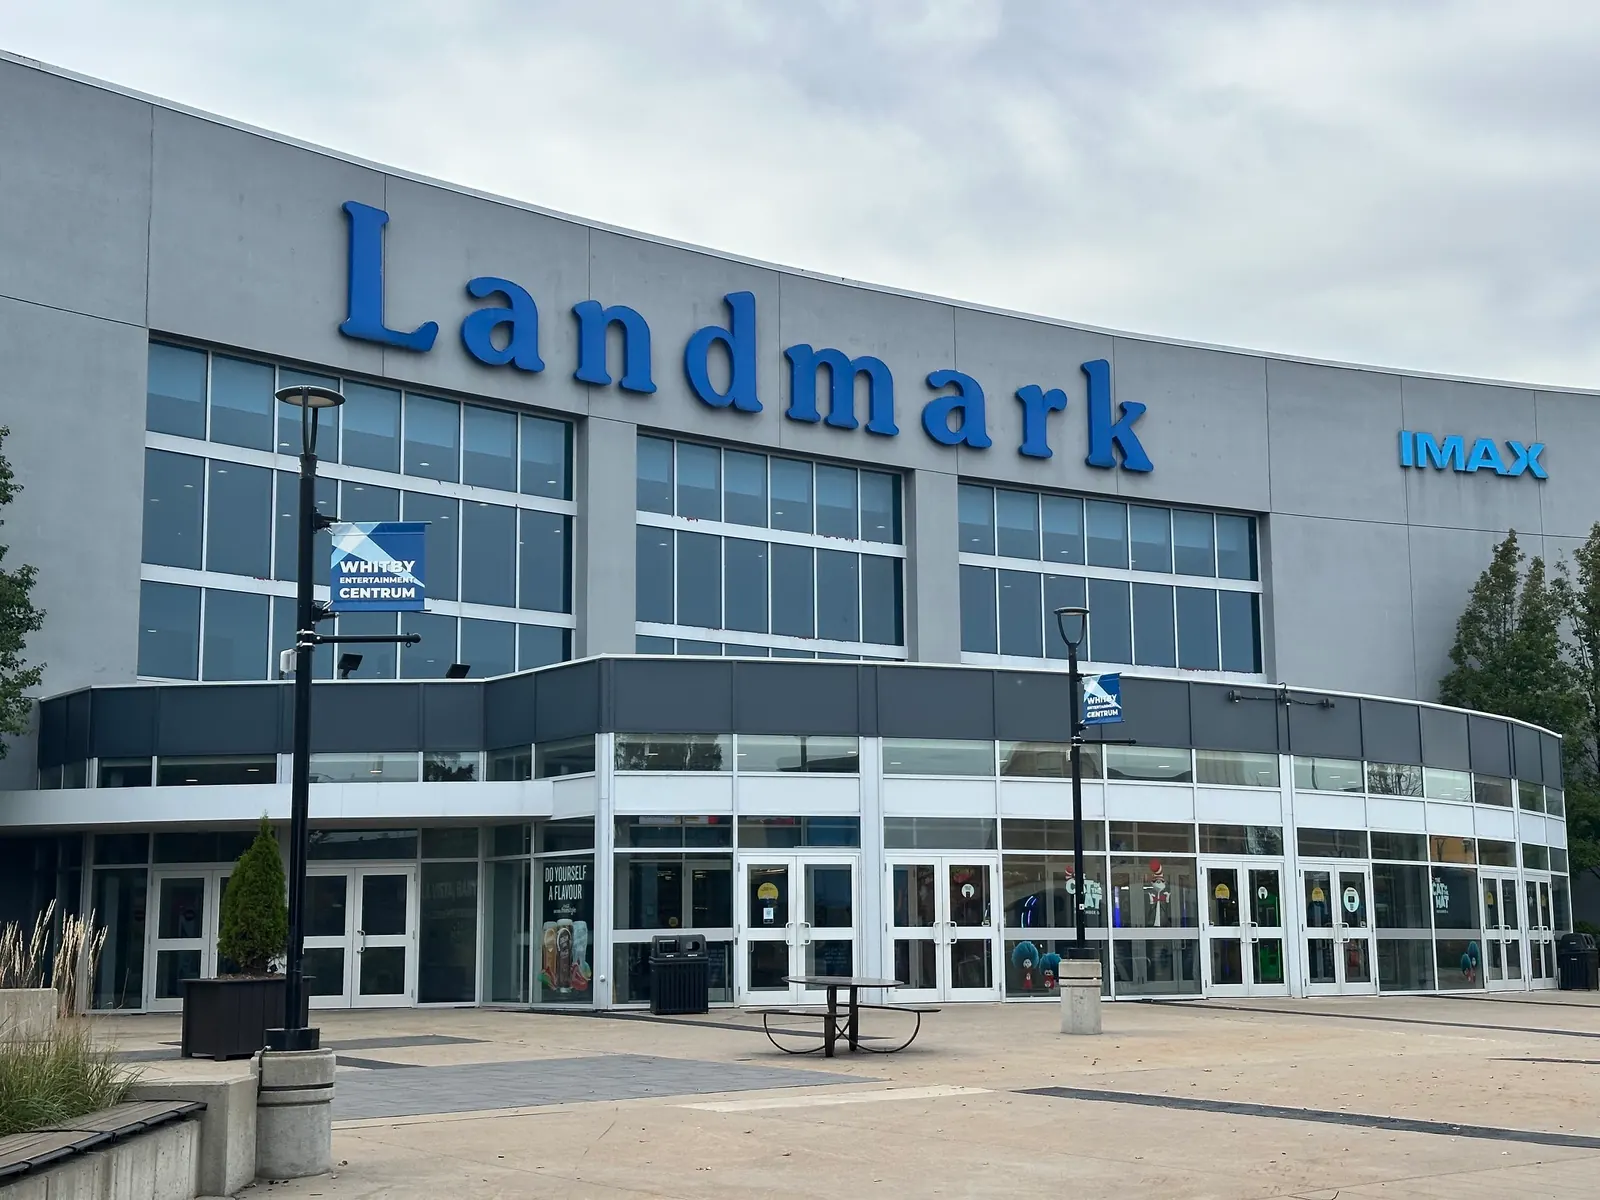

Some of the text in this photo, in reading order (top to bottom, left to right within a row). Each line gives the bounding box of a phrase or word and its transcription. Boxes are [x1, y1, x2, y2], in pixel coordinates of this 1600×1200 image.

[338, 200, 1154, 473] Landmark
[1398, 430, 1549, 480] IMAX
[340, 560, 416, 574] WHITBY
[340, 576, 416, 584] ENTERTAINMENT
[339, 587, 416, 599] CENTRUM
[1087, 694, 1118, 704] WHITBY
[1087, 709, 1118, 718] CENTRUM
[544, 865, 587, 882] DO YOURSELF
[548, 884, 583, 901] A FLAVOUR
[1436, 895, 1449, 909] HAT
